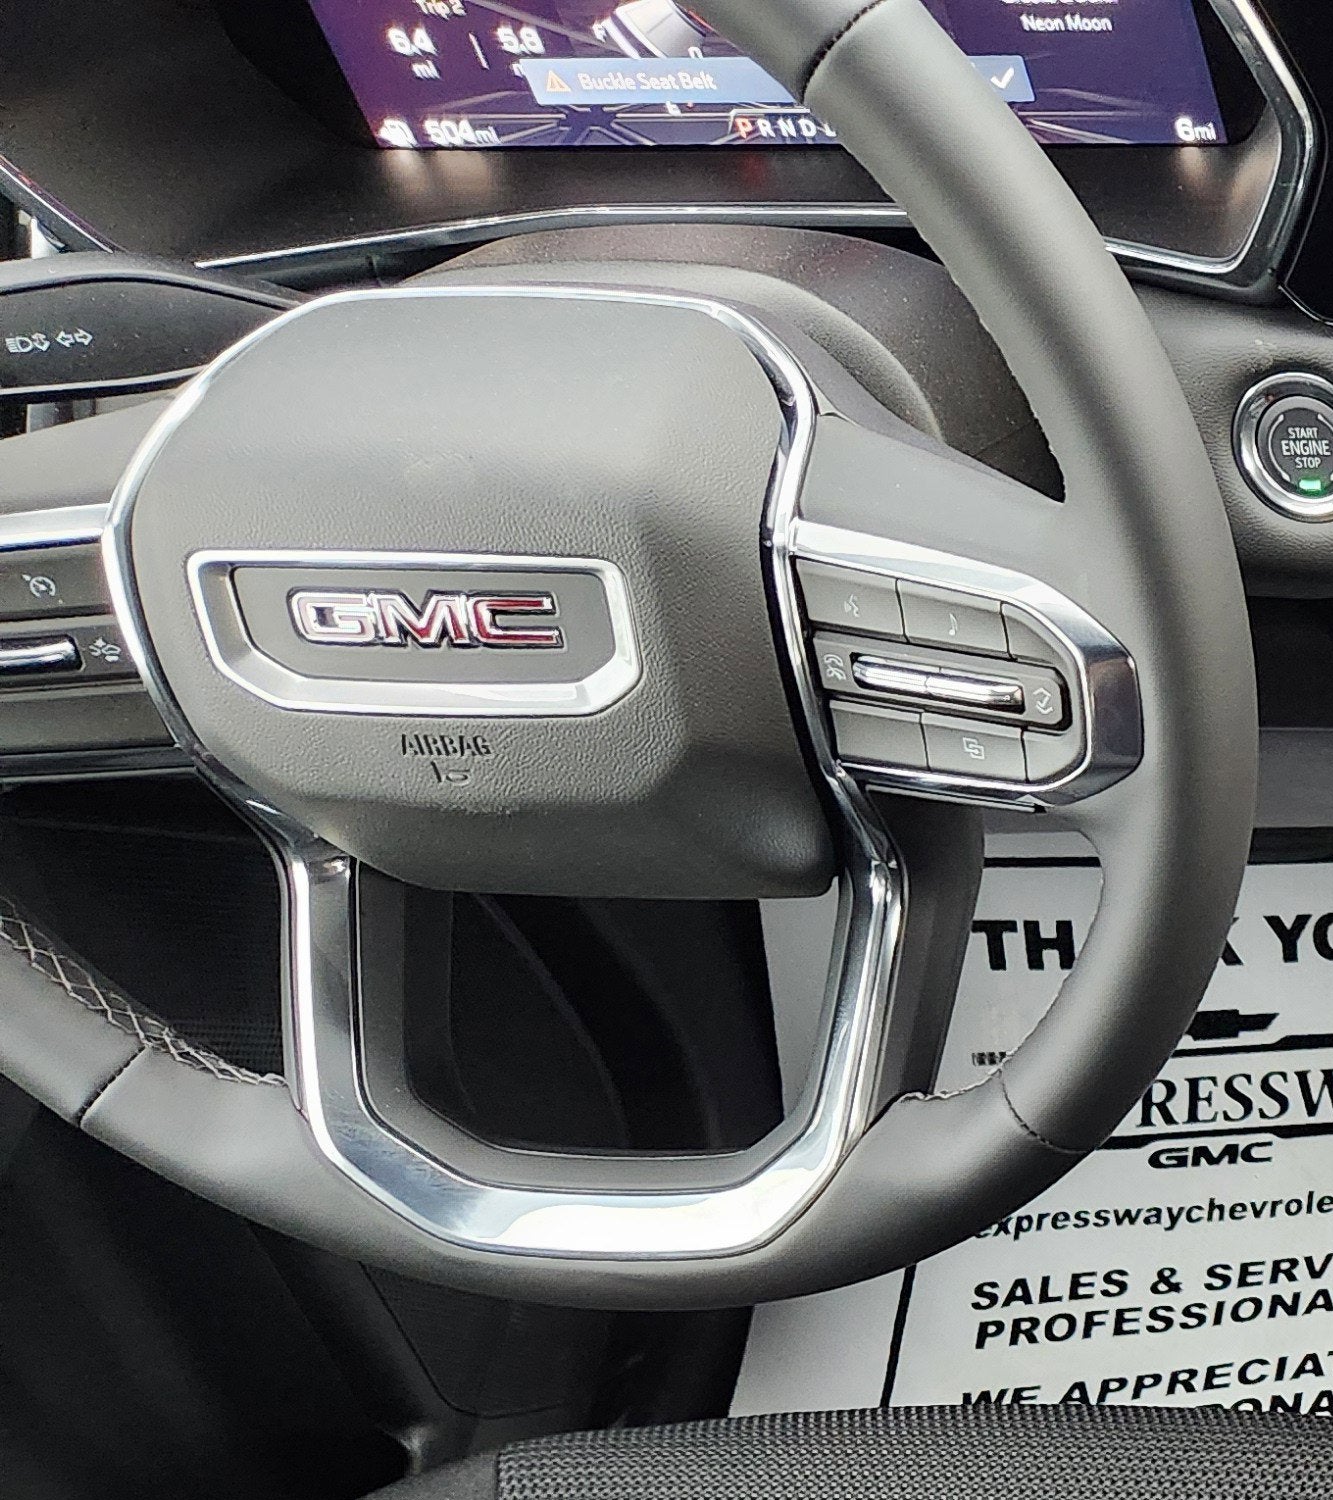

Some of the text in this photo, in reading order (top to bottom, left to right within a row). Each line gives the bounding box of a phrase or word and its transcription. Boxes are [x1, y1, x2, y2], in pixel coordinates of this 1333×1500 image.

[1020, 13, 1113, 32] Neon Moon
[578, 71, 717, 91] Buckle Seat Belt
[1287, 427, 1319, 439] START
[1281, 440, 1331, 456] ENGINE
[1294, 457, 1321, 469] STOP
[288, 588, 564, 649] GMC
[401, 733, 491, 757] AIRBAG
[1147, 1141, 1274, 1169] GMC
[971, 1268, 1129, 1311] SALES
[1149, 1266, 1183, 1295] &
